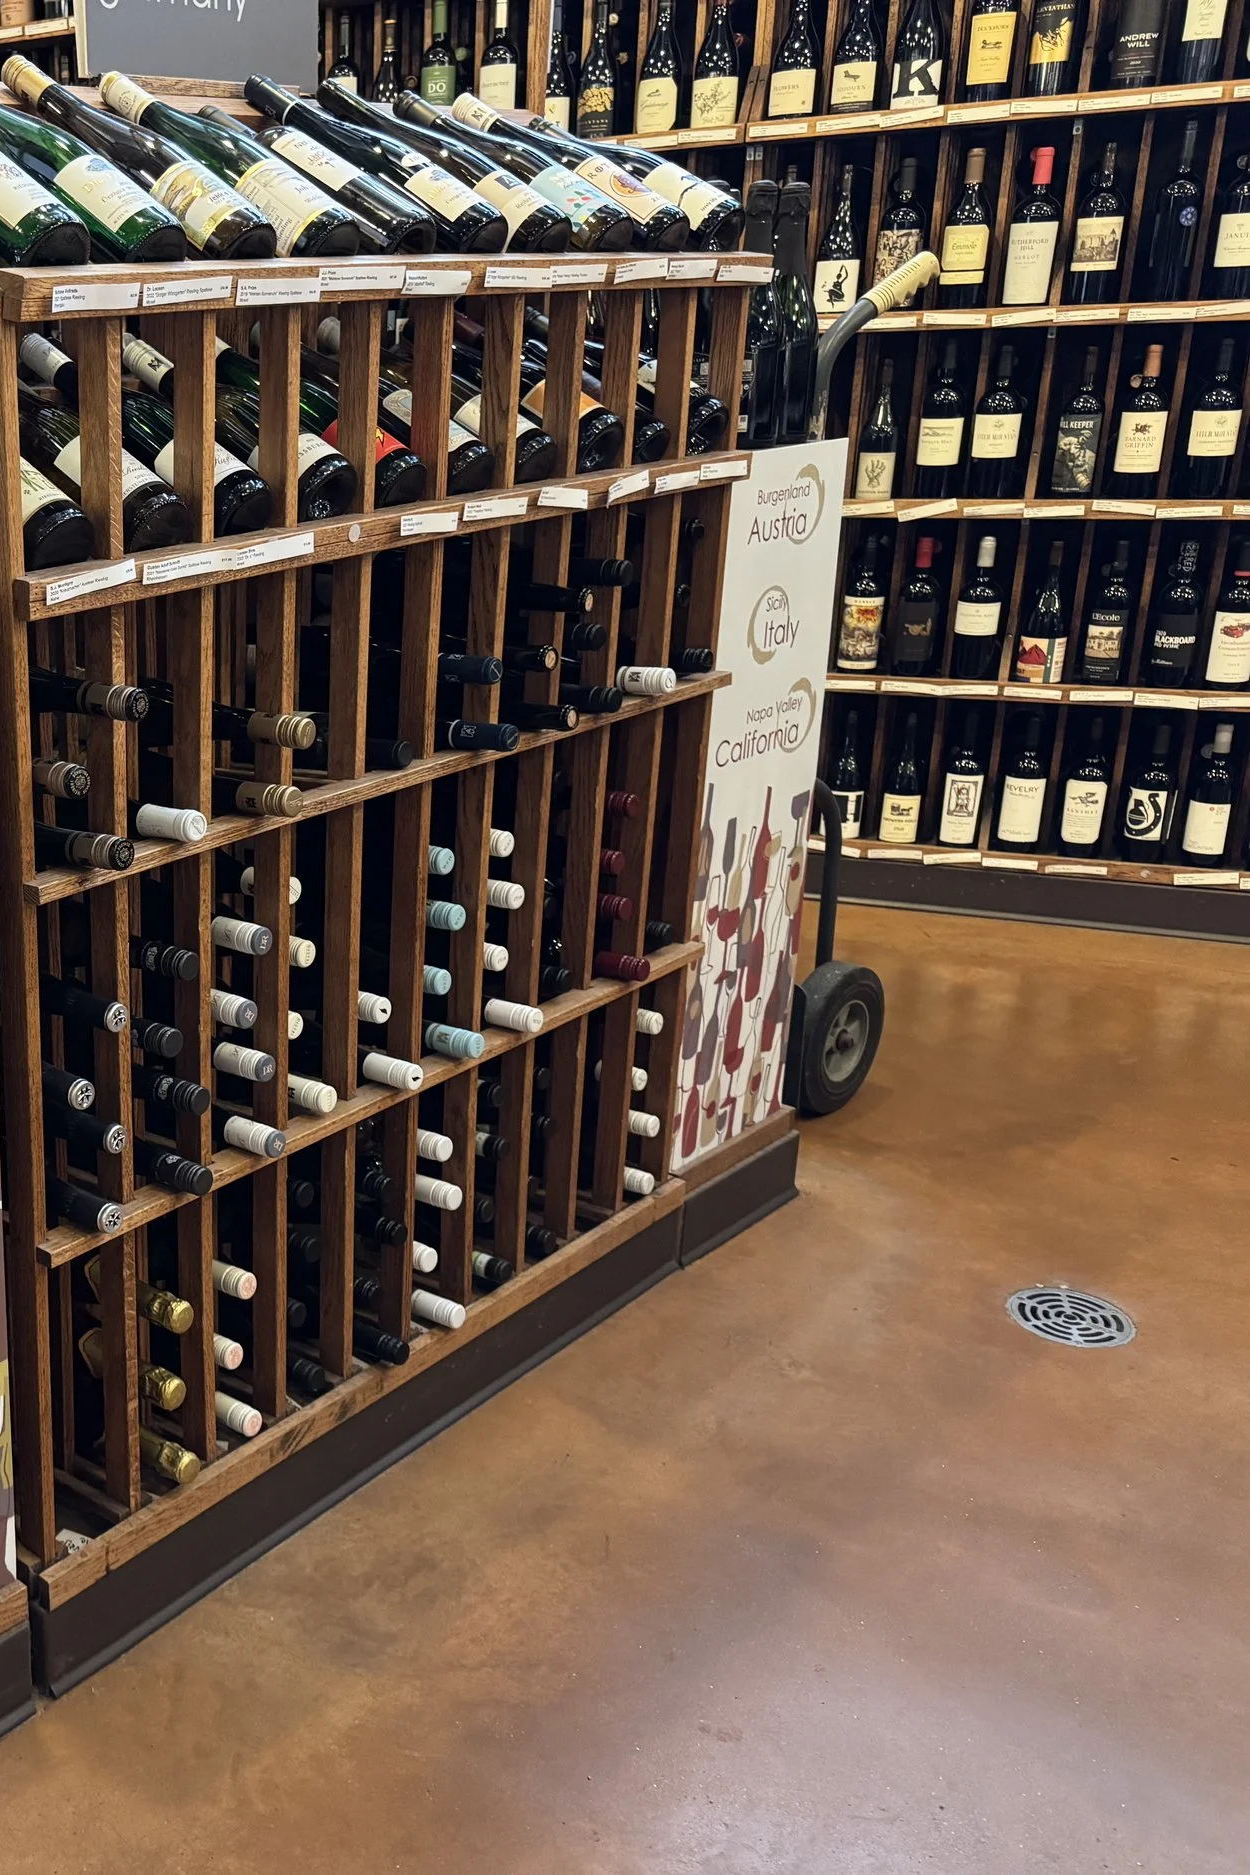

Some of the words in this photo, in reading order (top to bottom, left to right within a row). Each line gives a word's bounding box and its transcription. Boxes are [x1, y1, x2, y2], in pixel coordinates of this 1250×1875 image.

[1119, 32, 1159, 42] ANDREW
[1127, 41, 1150, 49] WILL
[427, 83, 447, 93] DO
[893, 59, 941, 99] K
[1070, 421, 1094, 429] KEEPER
[757, 481, 811, 506] Burgenland
[748, 508, 808, 545] Austria
[765, 593, 787, 613] Sicily
[763, 615, 800, 650] Italy
[1154, 634, 1196, 645] BLACKBOARD
[747, 703, 773, 725] Napa
[776, 696, 803, 716] Valley
[715, 720, 800, 768] California
